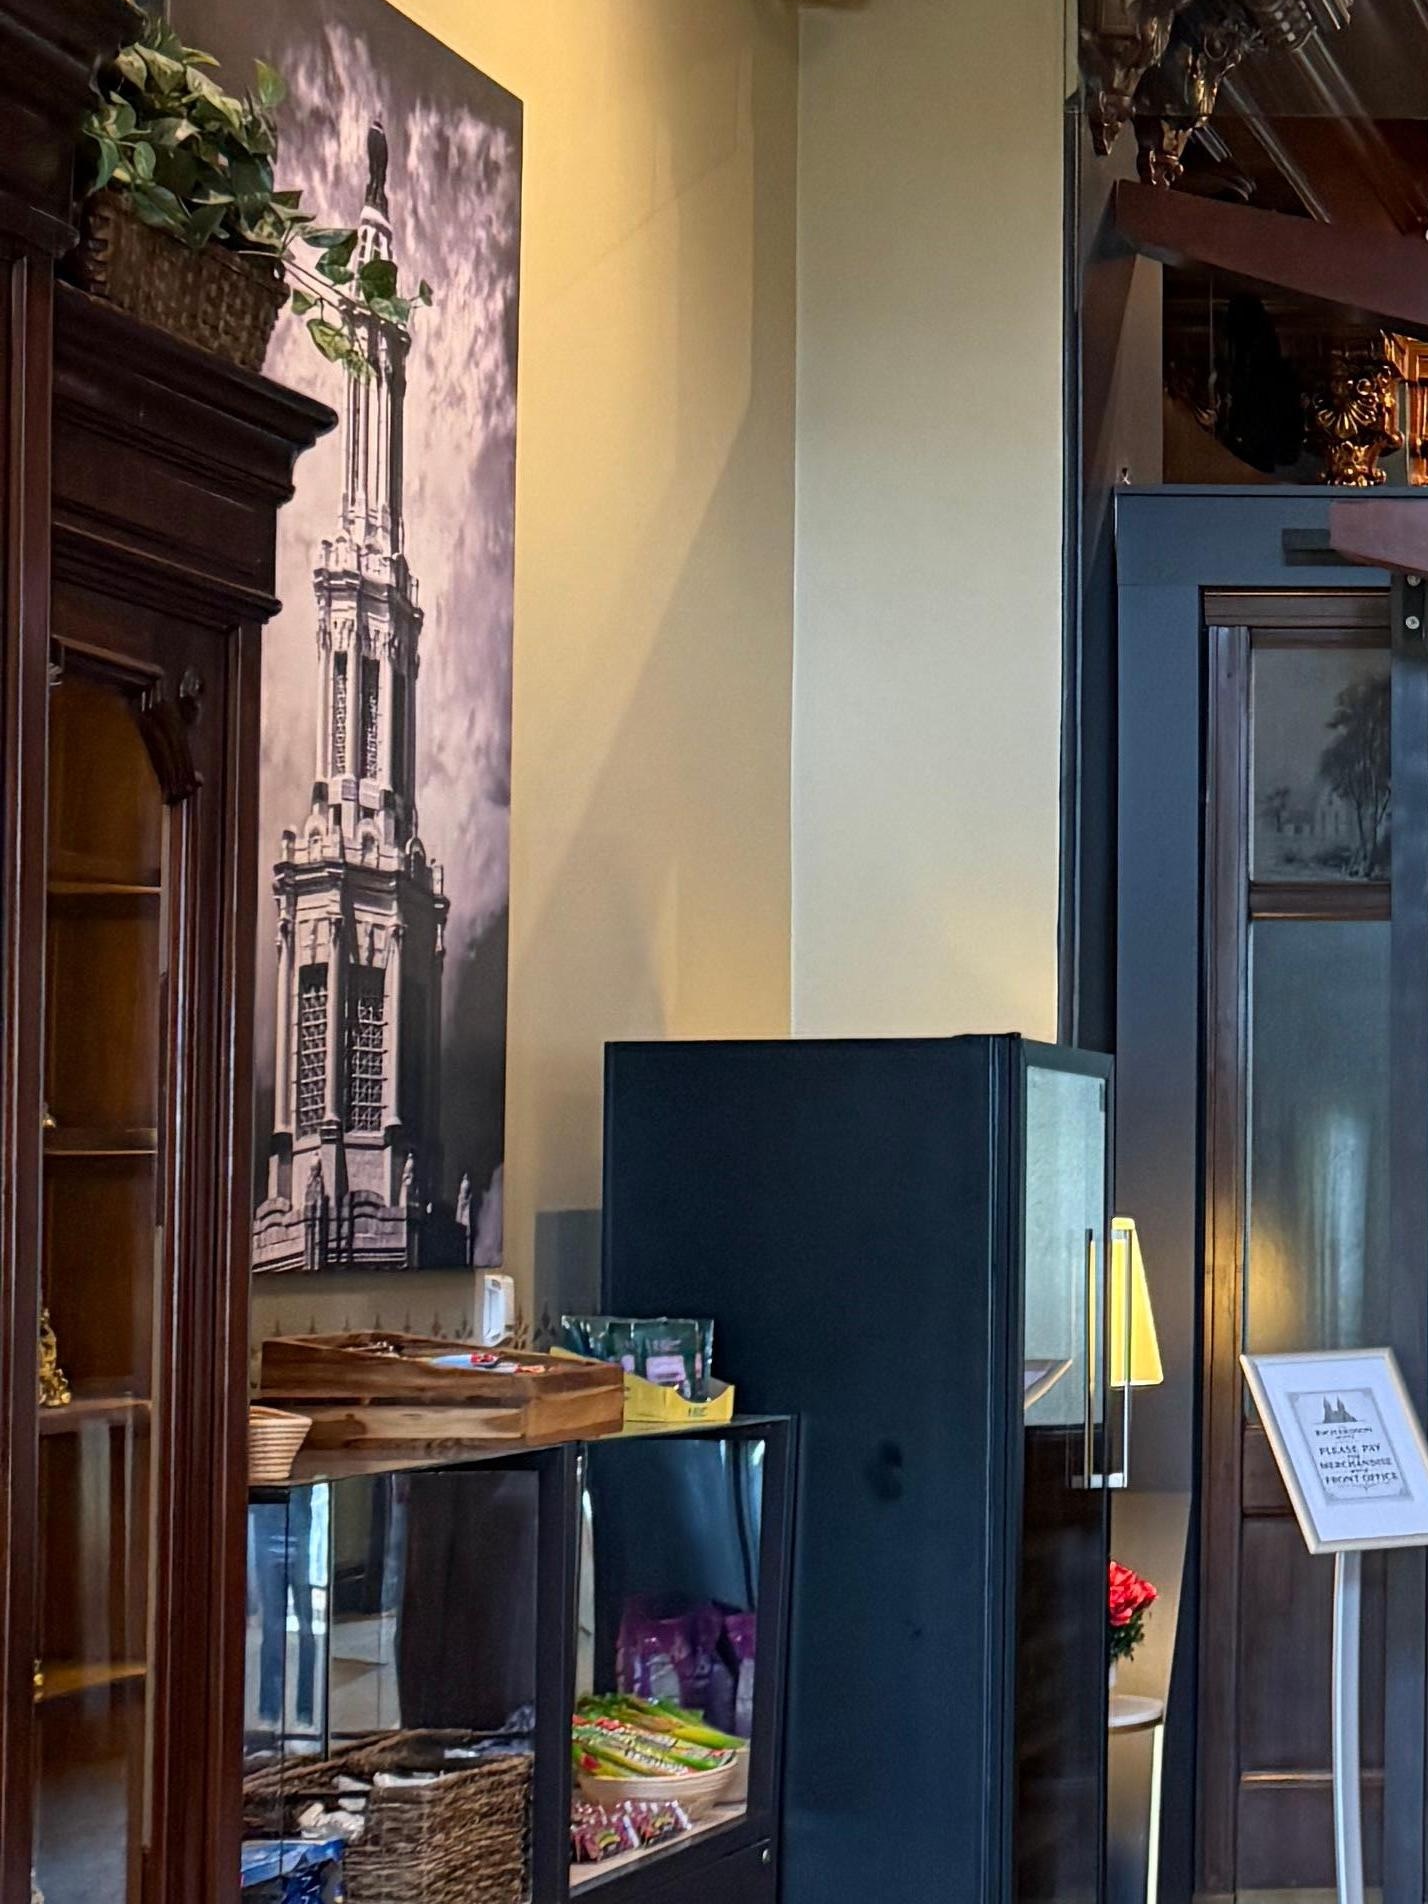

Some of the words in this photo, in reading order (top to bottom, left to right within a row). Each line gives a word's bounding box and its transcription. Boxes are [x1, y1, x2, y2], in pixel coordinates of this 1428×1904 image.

[1319, 1444, 1357, 1455] PLEASE
[1361, 1443, 1380, 1452] PAY
[1320, 1457, 1392, 1469] MERCHANDISE
[1325, 1474, 1359, 1484] FRONT
[1362, 1472, 1398, 1482] OFFICE
